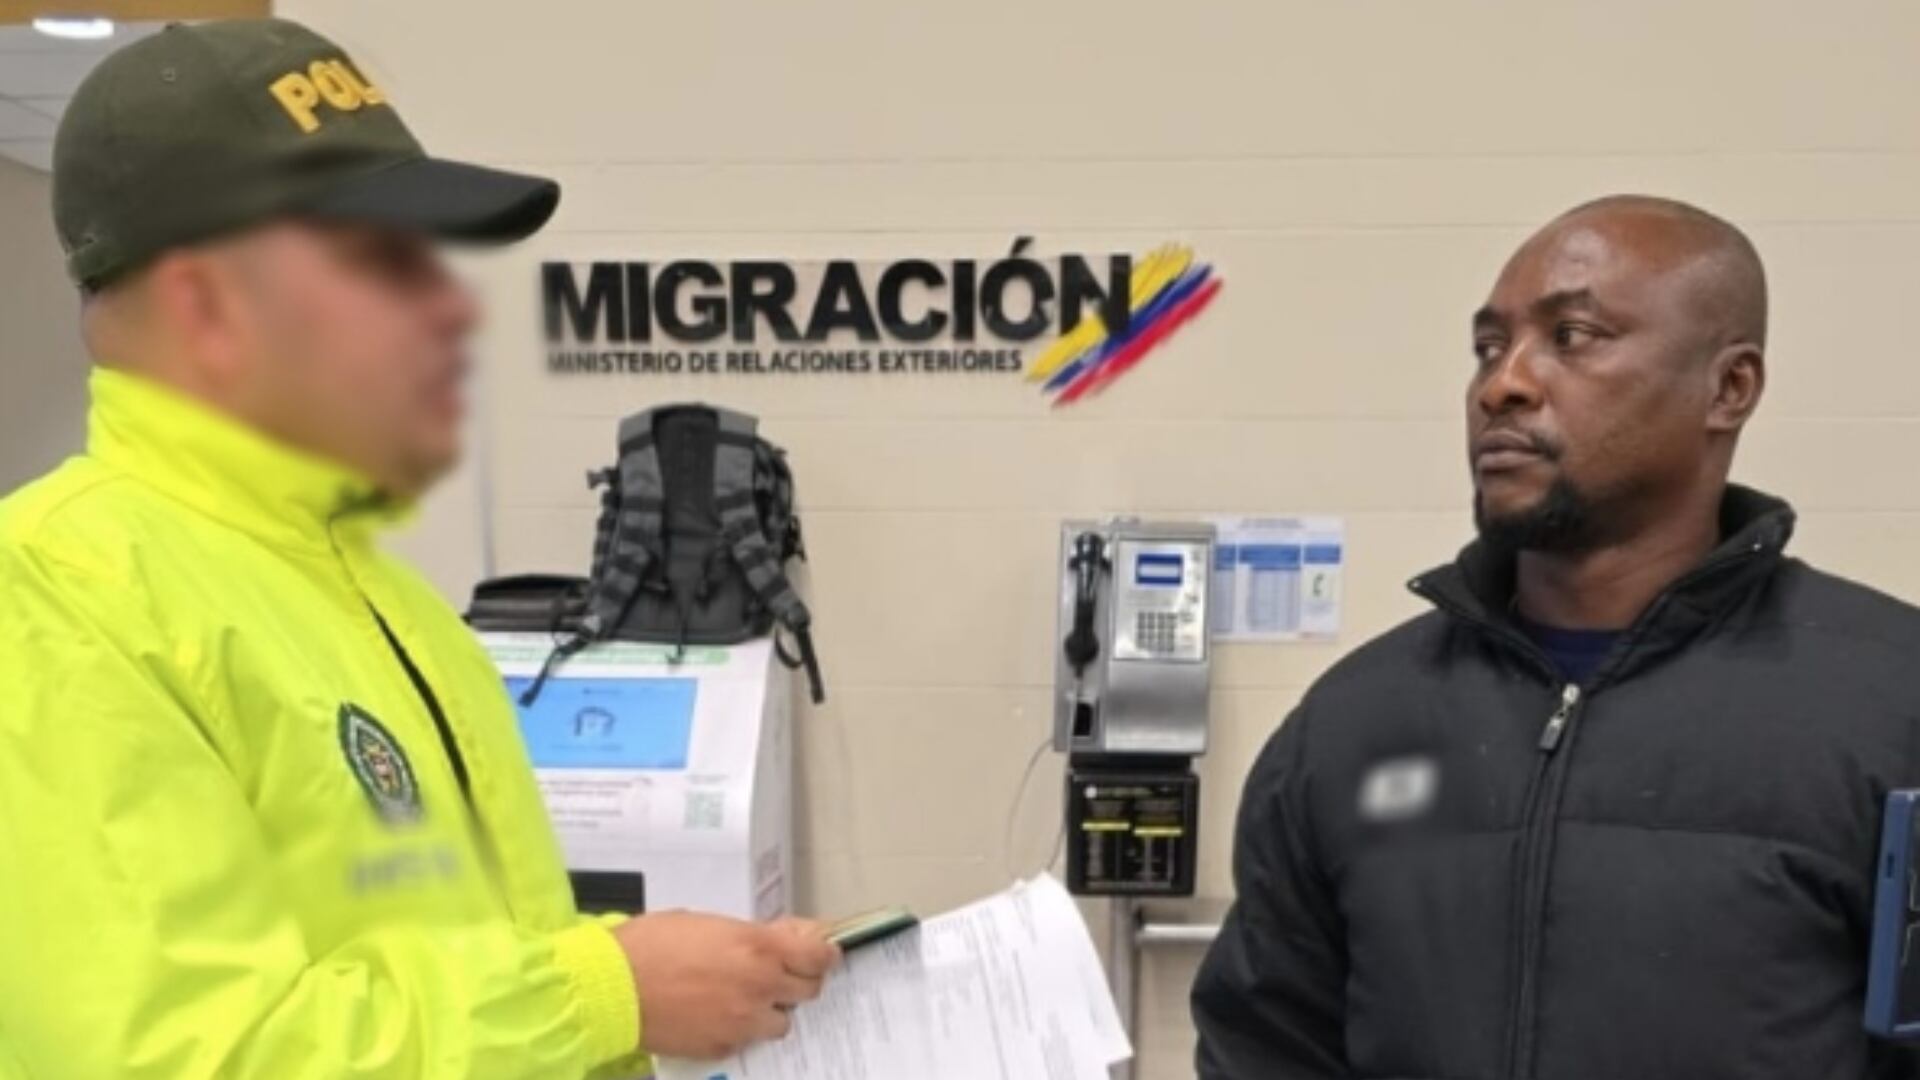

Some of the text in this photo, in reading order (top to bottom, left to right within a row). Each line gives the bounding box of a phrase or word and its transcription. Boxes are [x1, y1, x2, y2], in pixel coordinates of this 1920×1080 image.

[541, 237, 1132, 343] MIGRACIÓN
[548, 349, 1022, 374] MINISTERIO DE RELACIONES EXTERIORES
